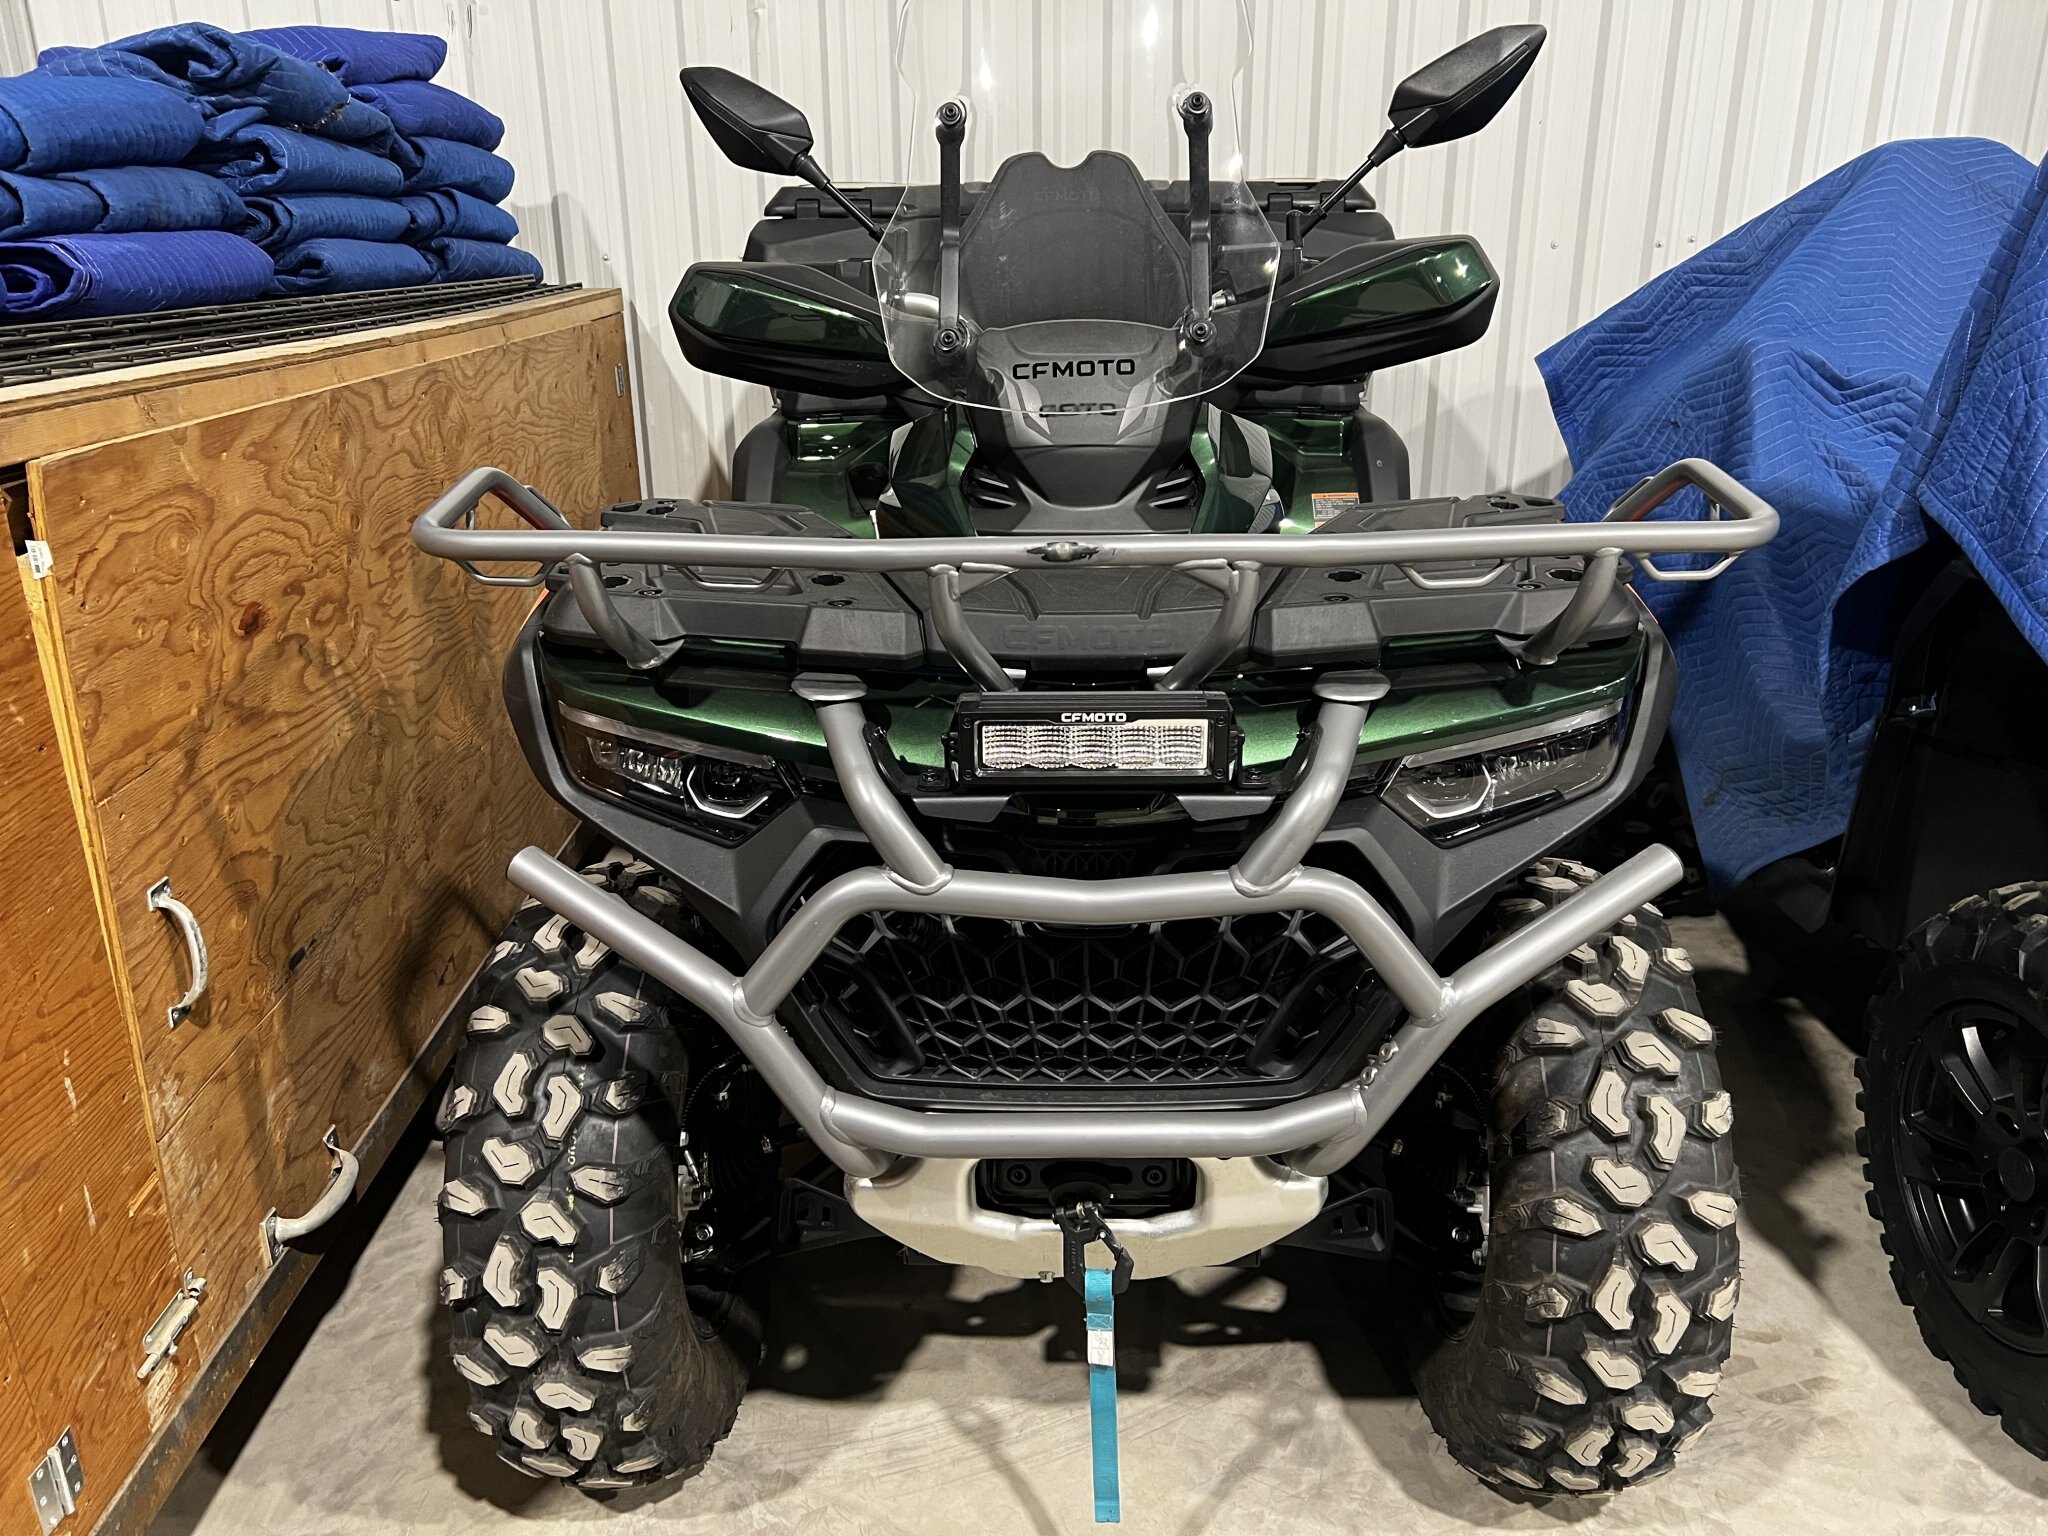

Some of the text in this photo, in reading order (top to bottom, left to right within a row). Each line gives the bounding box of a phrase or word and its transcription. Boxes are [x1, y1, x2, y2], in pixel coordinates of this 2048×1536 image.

[1012, 358, 1136, 380] CFMOTO
[1003, 623, 1173, 650] CFMOTO
[1060, 712, 1127, 723] CFMOTO
